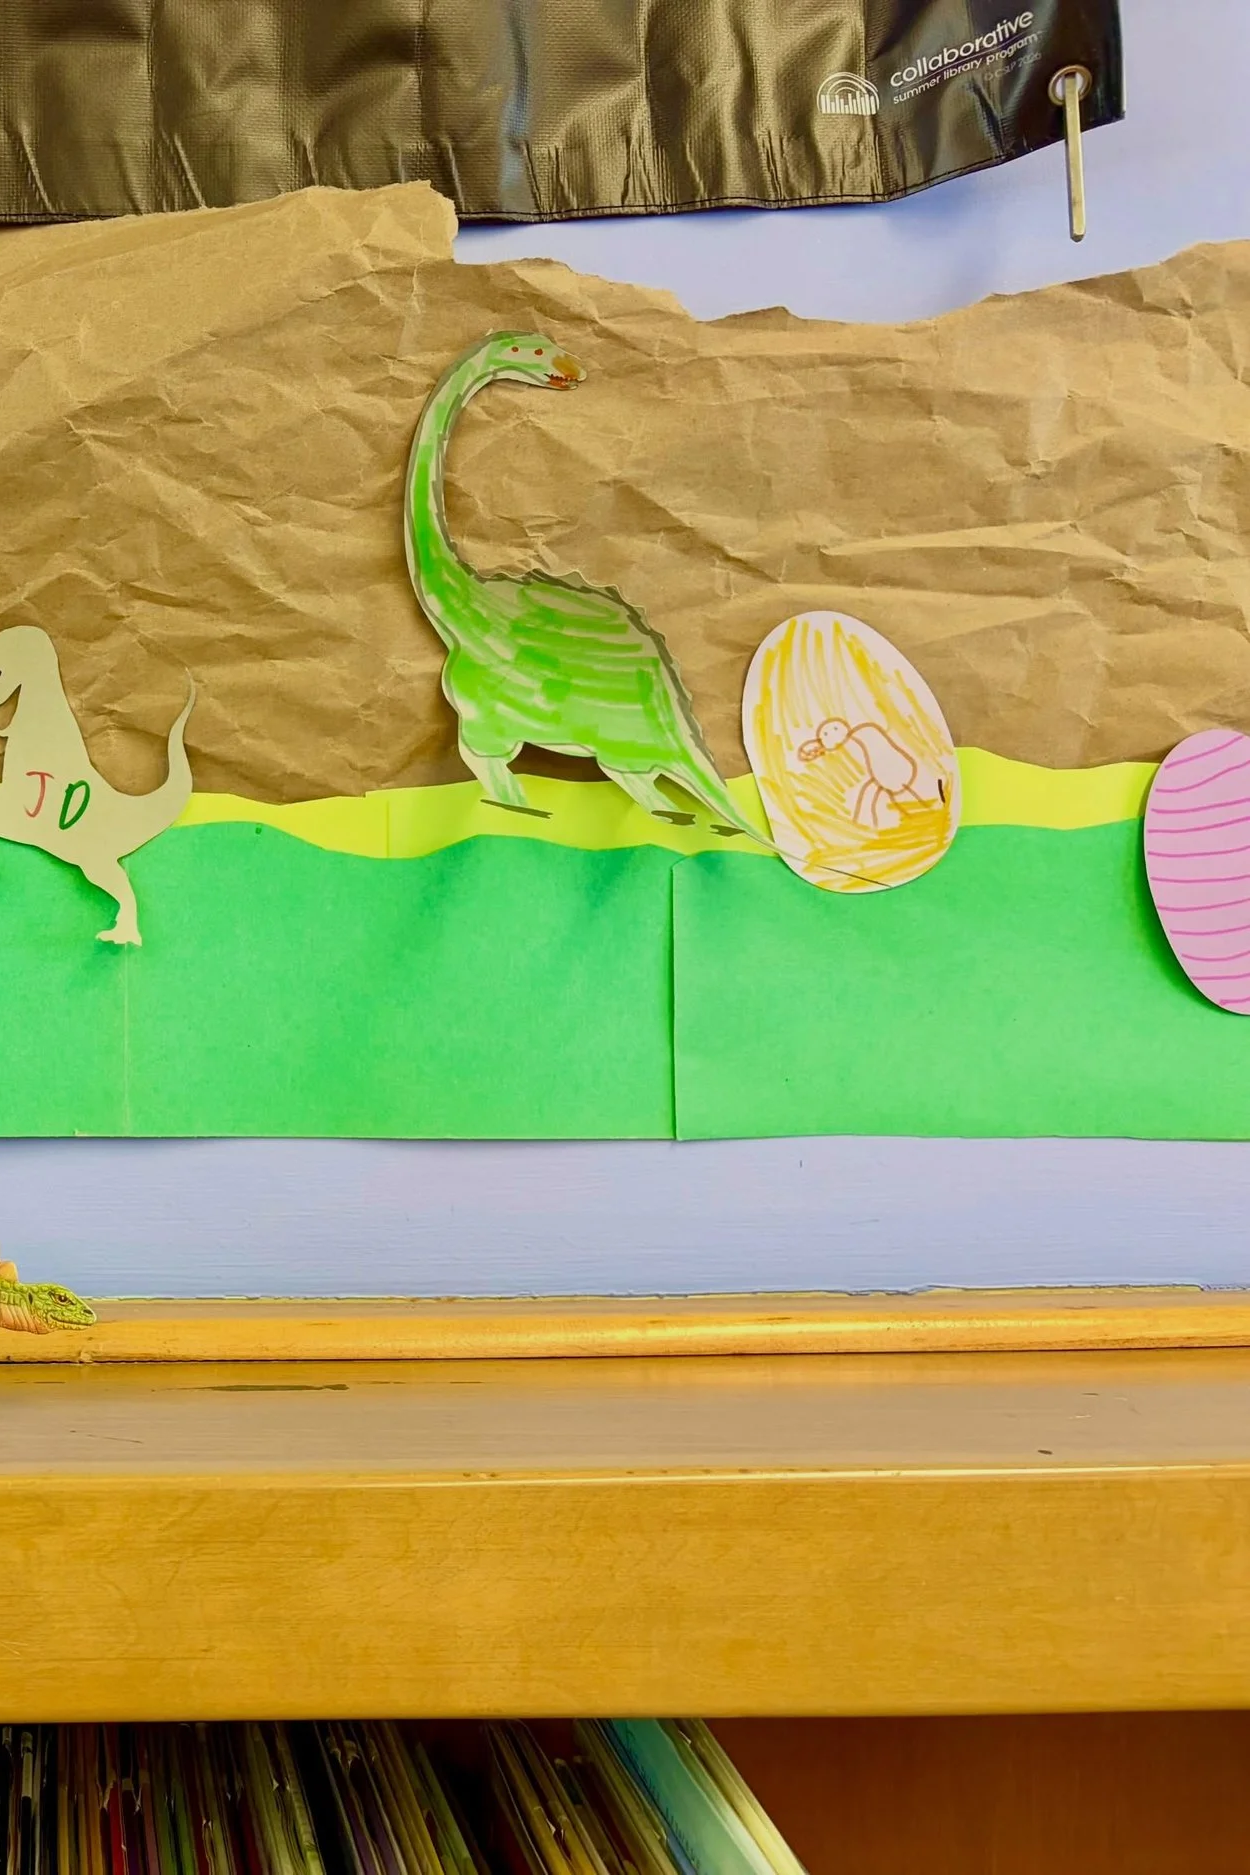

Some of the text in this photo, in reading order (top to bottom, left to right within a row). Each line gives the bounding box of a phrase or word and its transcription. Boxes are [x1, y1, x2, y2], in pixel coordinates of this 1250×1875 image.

[890, 11, 1034, 87] collaborative
[893, 75, 941, 104] summer
[943, 57, 982, 80] library
